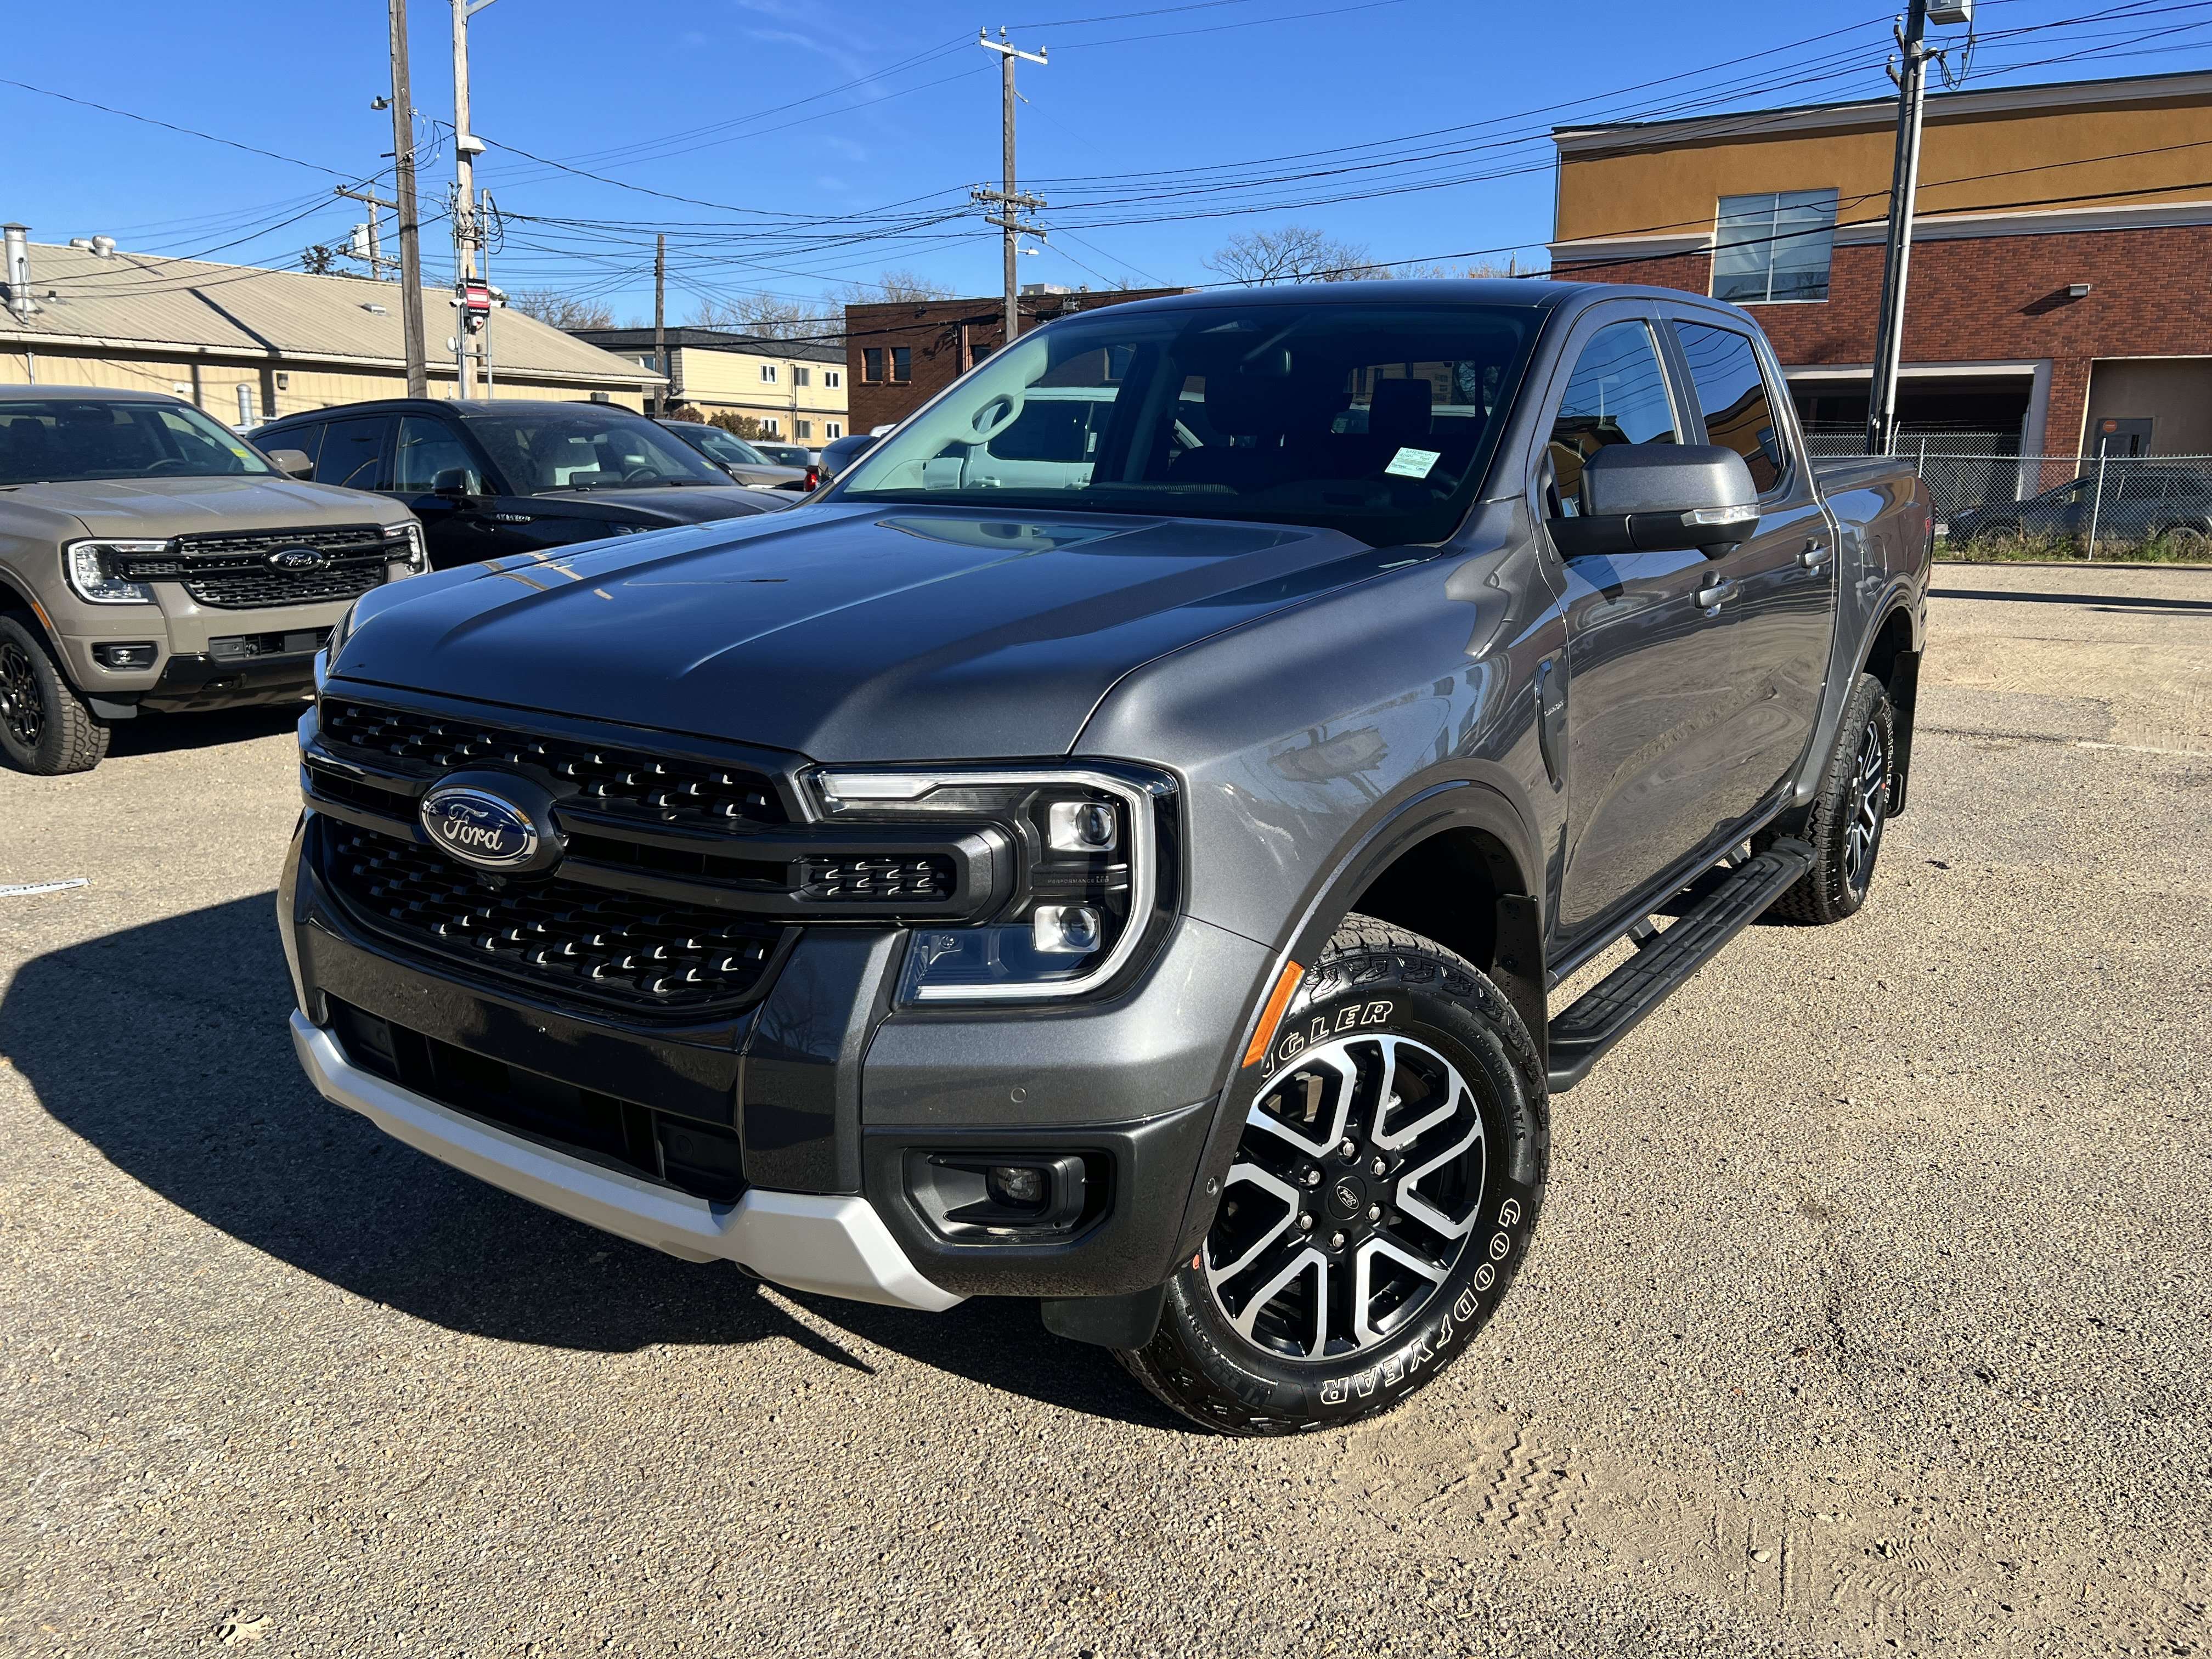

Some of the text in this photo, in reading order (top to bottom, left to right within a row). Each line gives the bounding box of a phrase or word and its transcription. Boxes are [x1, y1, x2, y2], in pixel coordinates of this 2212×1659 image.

[444, 803, 503, 850] Ford
[1262, 1000, 1393, 1079] GLER
[1340, 1189, 1357, 1206] Ford
[1320, 1198, 1521, 1405] GOODYEAR
